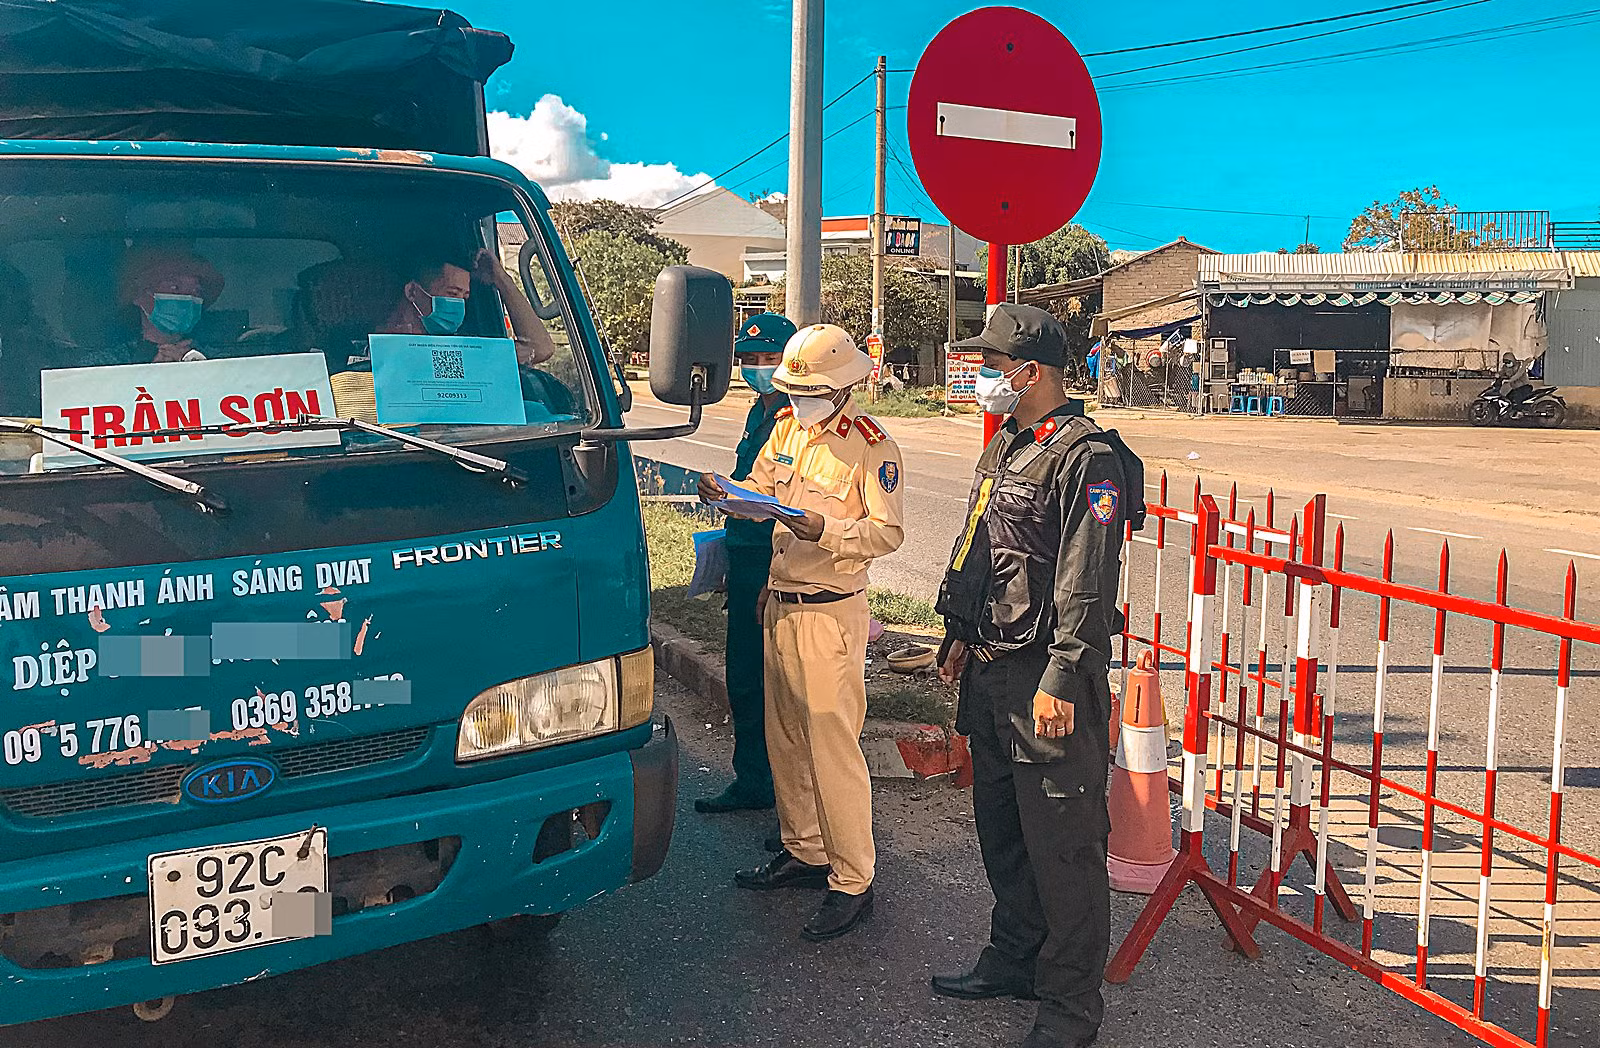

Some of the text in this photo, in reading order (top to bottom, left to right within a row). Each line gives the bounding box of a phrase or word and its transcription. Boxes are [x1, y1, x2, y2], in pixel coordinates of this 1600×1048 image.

[60, 386, 321, 452] TRẦN SƠN
[391, 530, 563, 570] FRONTIER
[50, 579, 145, 617] THANH
[157, 568, 214, 605] ÁNH
[232, 559, 303, 597] SÁNG
[315, 557, 372, 590] DVAT
[12, 638, 98, 697] DIỆP
[231, 680, 298, 731] 0369
[202, 768, 262, 796] KIA
[196, 845, 286, 898] 92C
